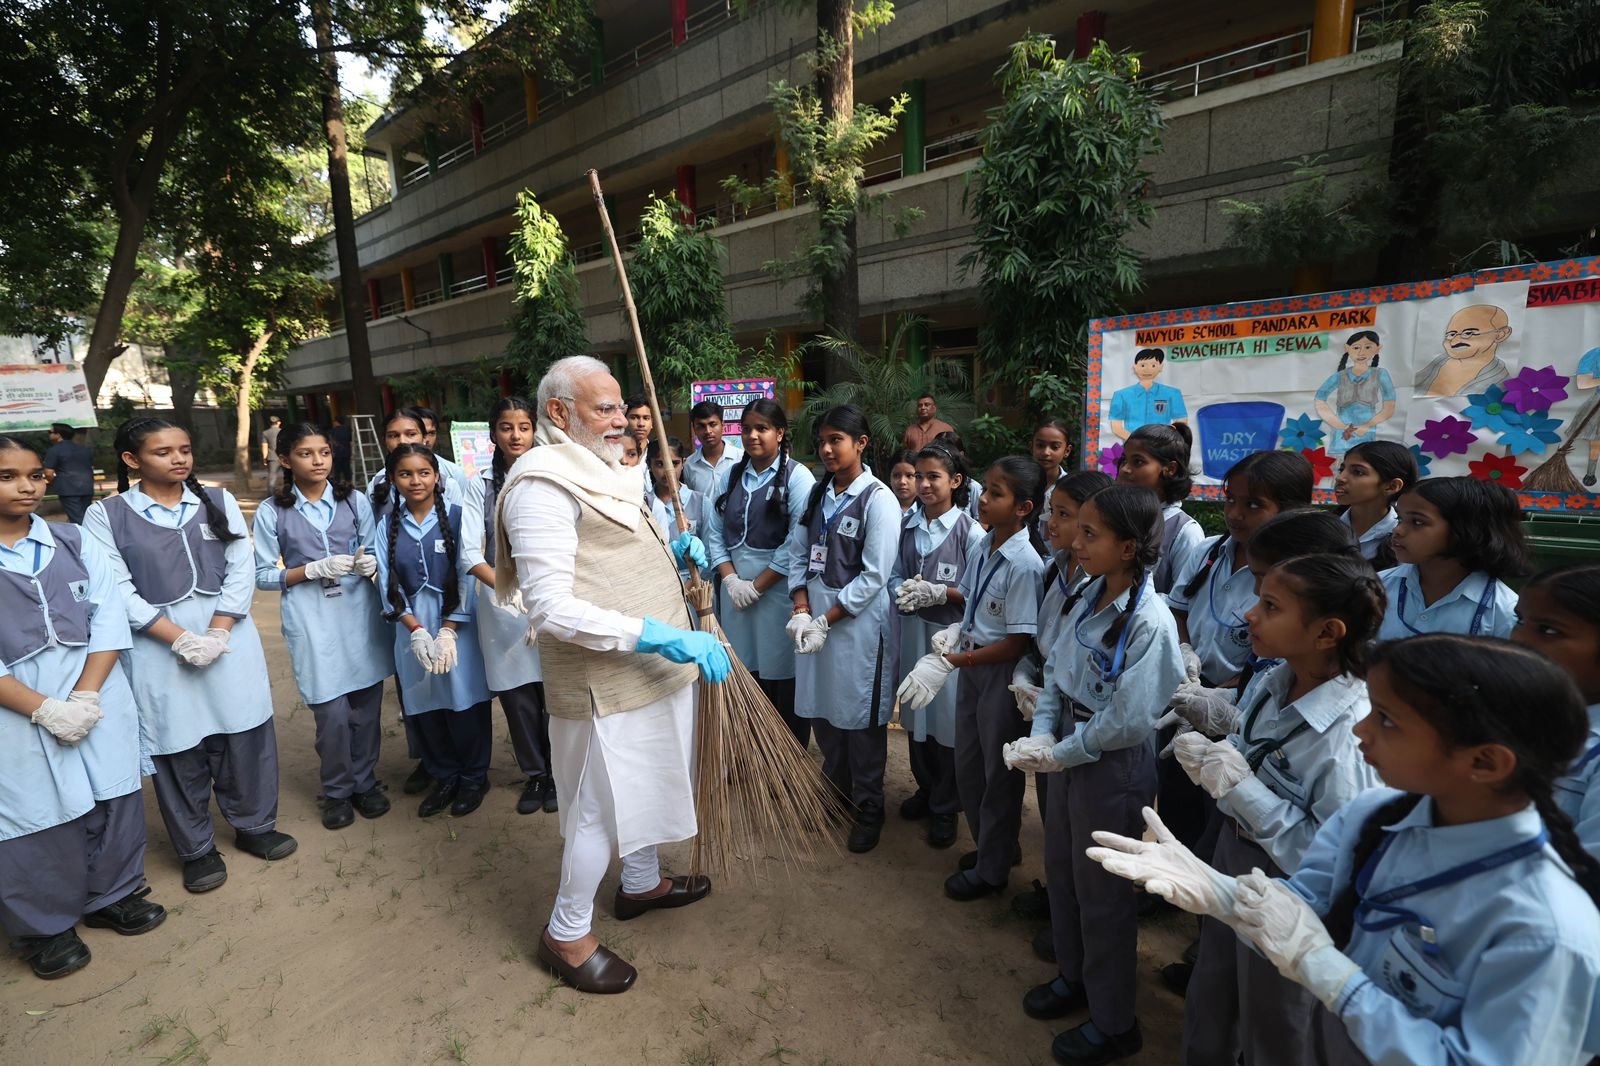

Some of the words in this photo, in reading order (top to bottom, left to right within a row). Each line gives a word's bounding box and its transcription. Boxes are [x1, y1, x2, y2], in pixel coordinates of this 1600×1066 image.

[1136, 328, 1185, 344] NAVYUG
[1192, 323, 1237, 339] SCHOOL
[1252, 314, 1319, 334] PANDARA
[1329, 309, 1371, 326] PARK
[1171, 342, 1245, 359] SWACHHTA
[1253, 340, 1268, 353] HI
[1275, 336, 1322, 352] SEWA
[1220, 432, 1257, 445] DRY
